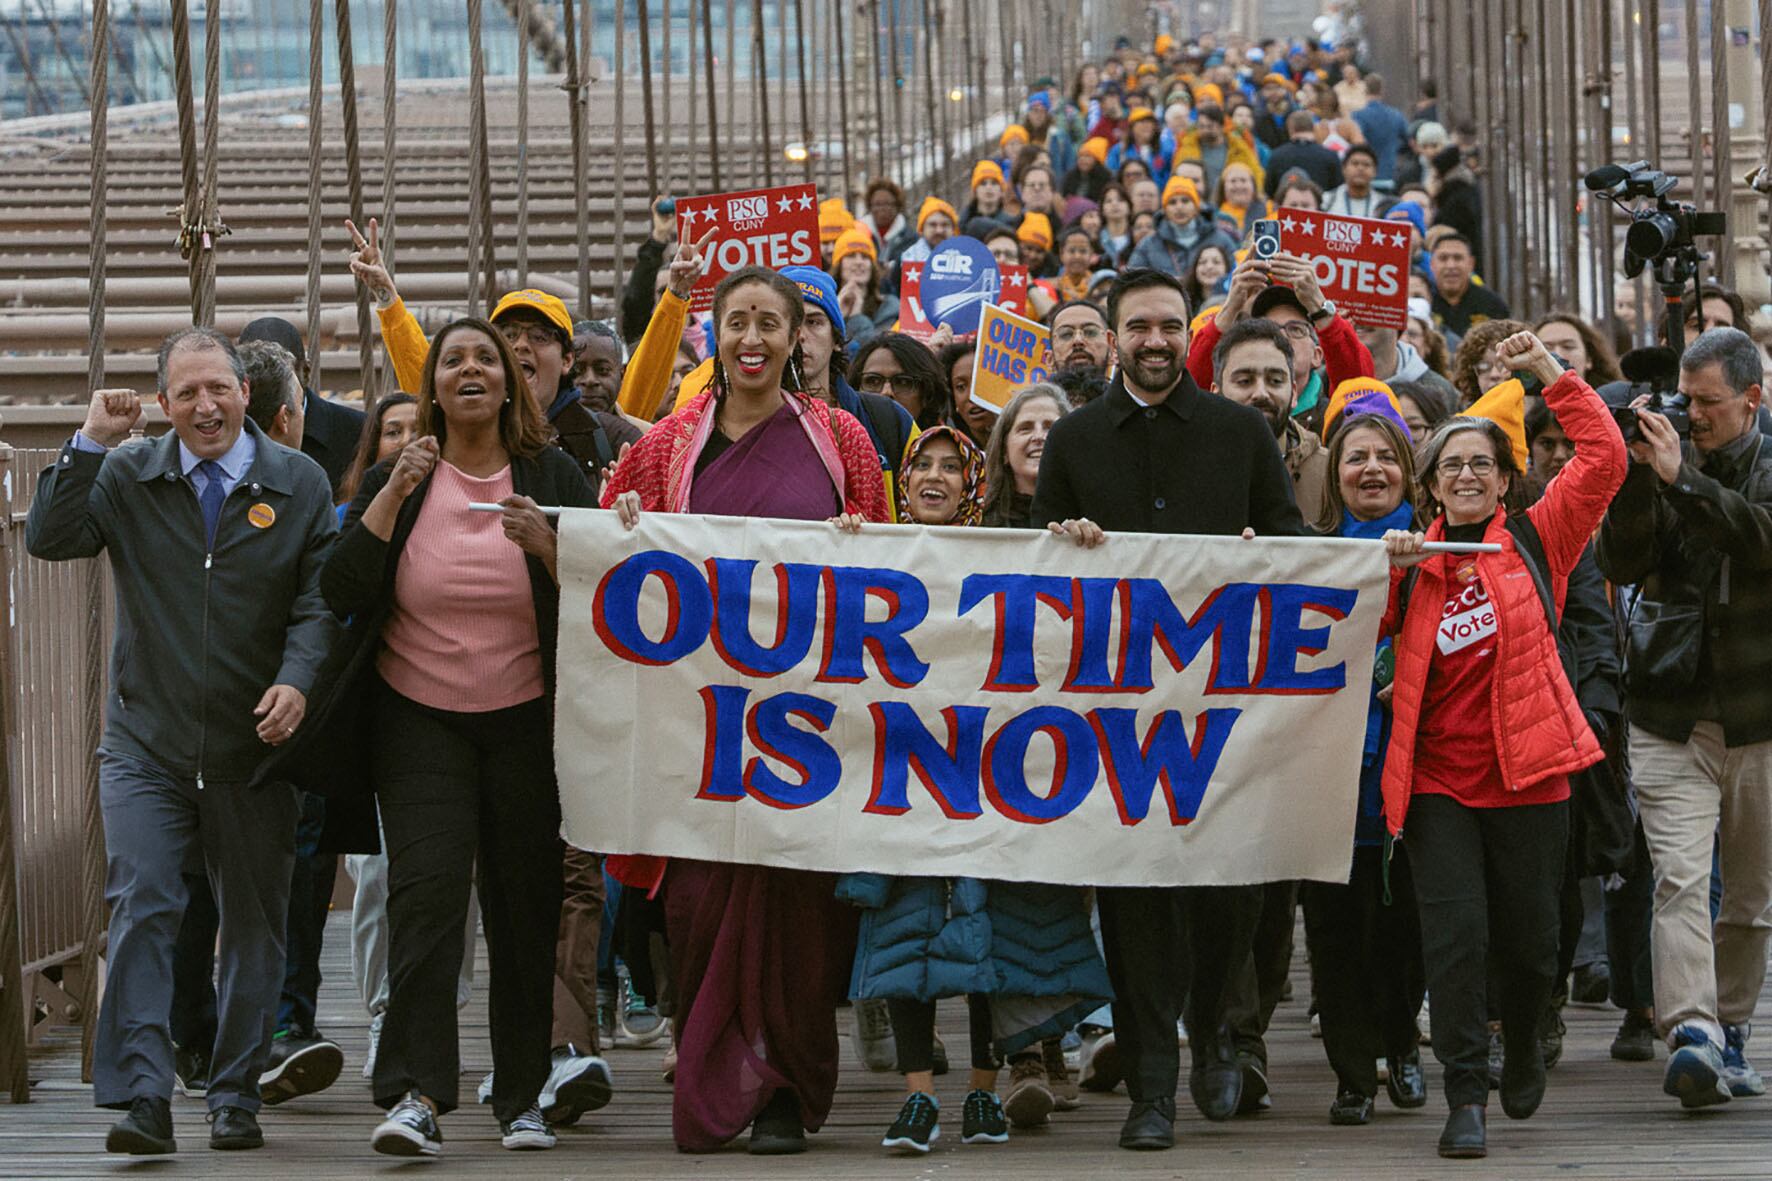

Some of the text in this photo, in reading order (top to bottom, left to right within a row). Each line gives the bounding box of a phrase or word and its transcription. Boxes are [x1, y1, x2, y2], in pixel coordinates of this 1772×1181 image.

[729, 197, 767, 219] PSC
[733, 218, 765, 232] CUNY
[1325, 220, 1361, 243] PSC
[1326, 241, 1358, 253] CUNY
[1283, 249, 1399, 296] OTES
[989, 317, 1037, 358] OUR
[981, 344, 1027, 385] HAS
[592, 550, 1359, 696] OUR TIME
[1440, 612, 1495, 642] Vote
[695, 684, 1243, 827] IS NOW
